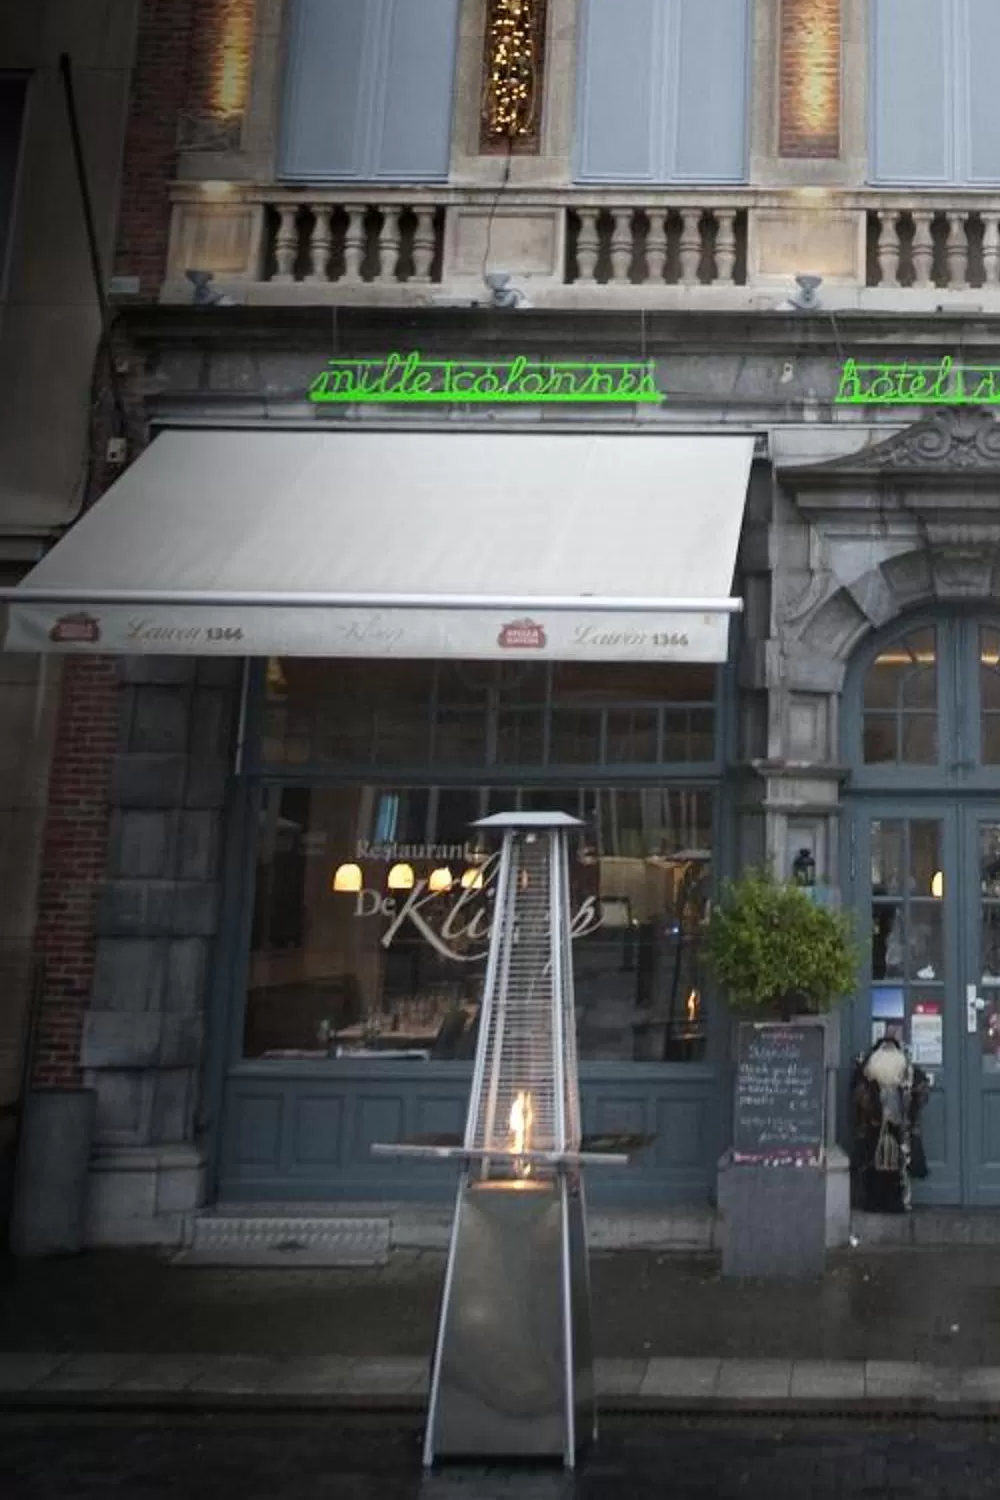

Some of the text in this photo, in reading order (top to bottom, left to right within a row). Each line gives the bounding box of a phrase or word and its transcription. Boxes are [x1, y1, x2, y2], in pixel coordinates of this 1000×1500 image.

[310, 351, 658, 399] mille colonnes
[838, 355, 953, 402] hotel
[355, 839, 473, 860] Restaurant
[353, 850, 606, 1002] De Klip
